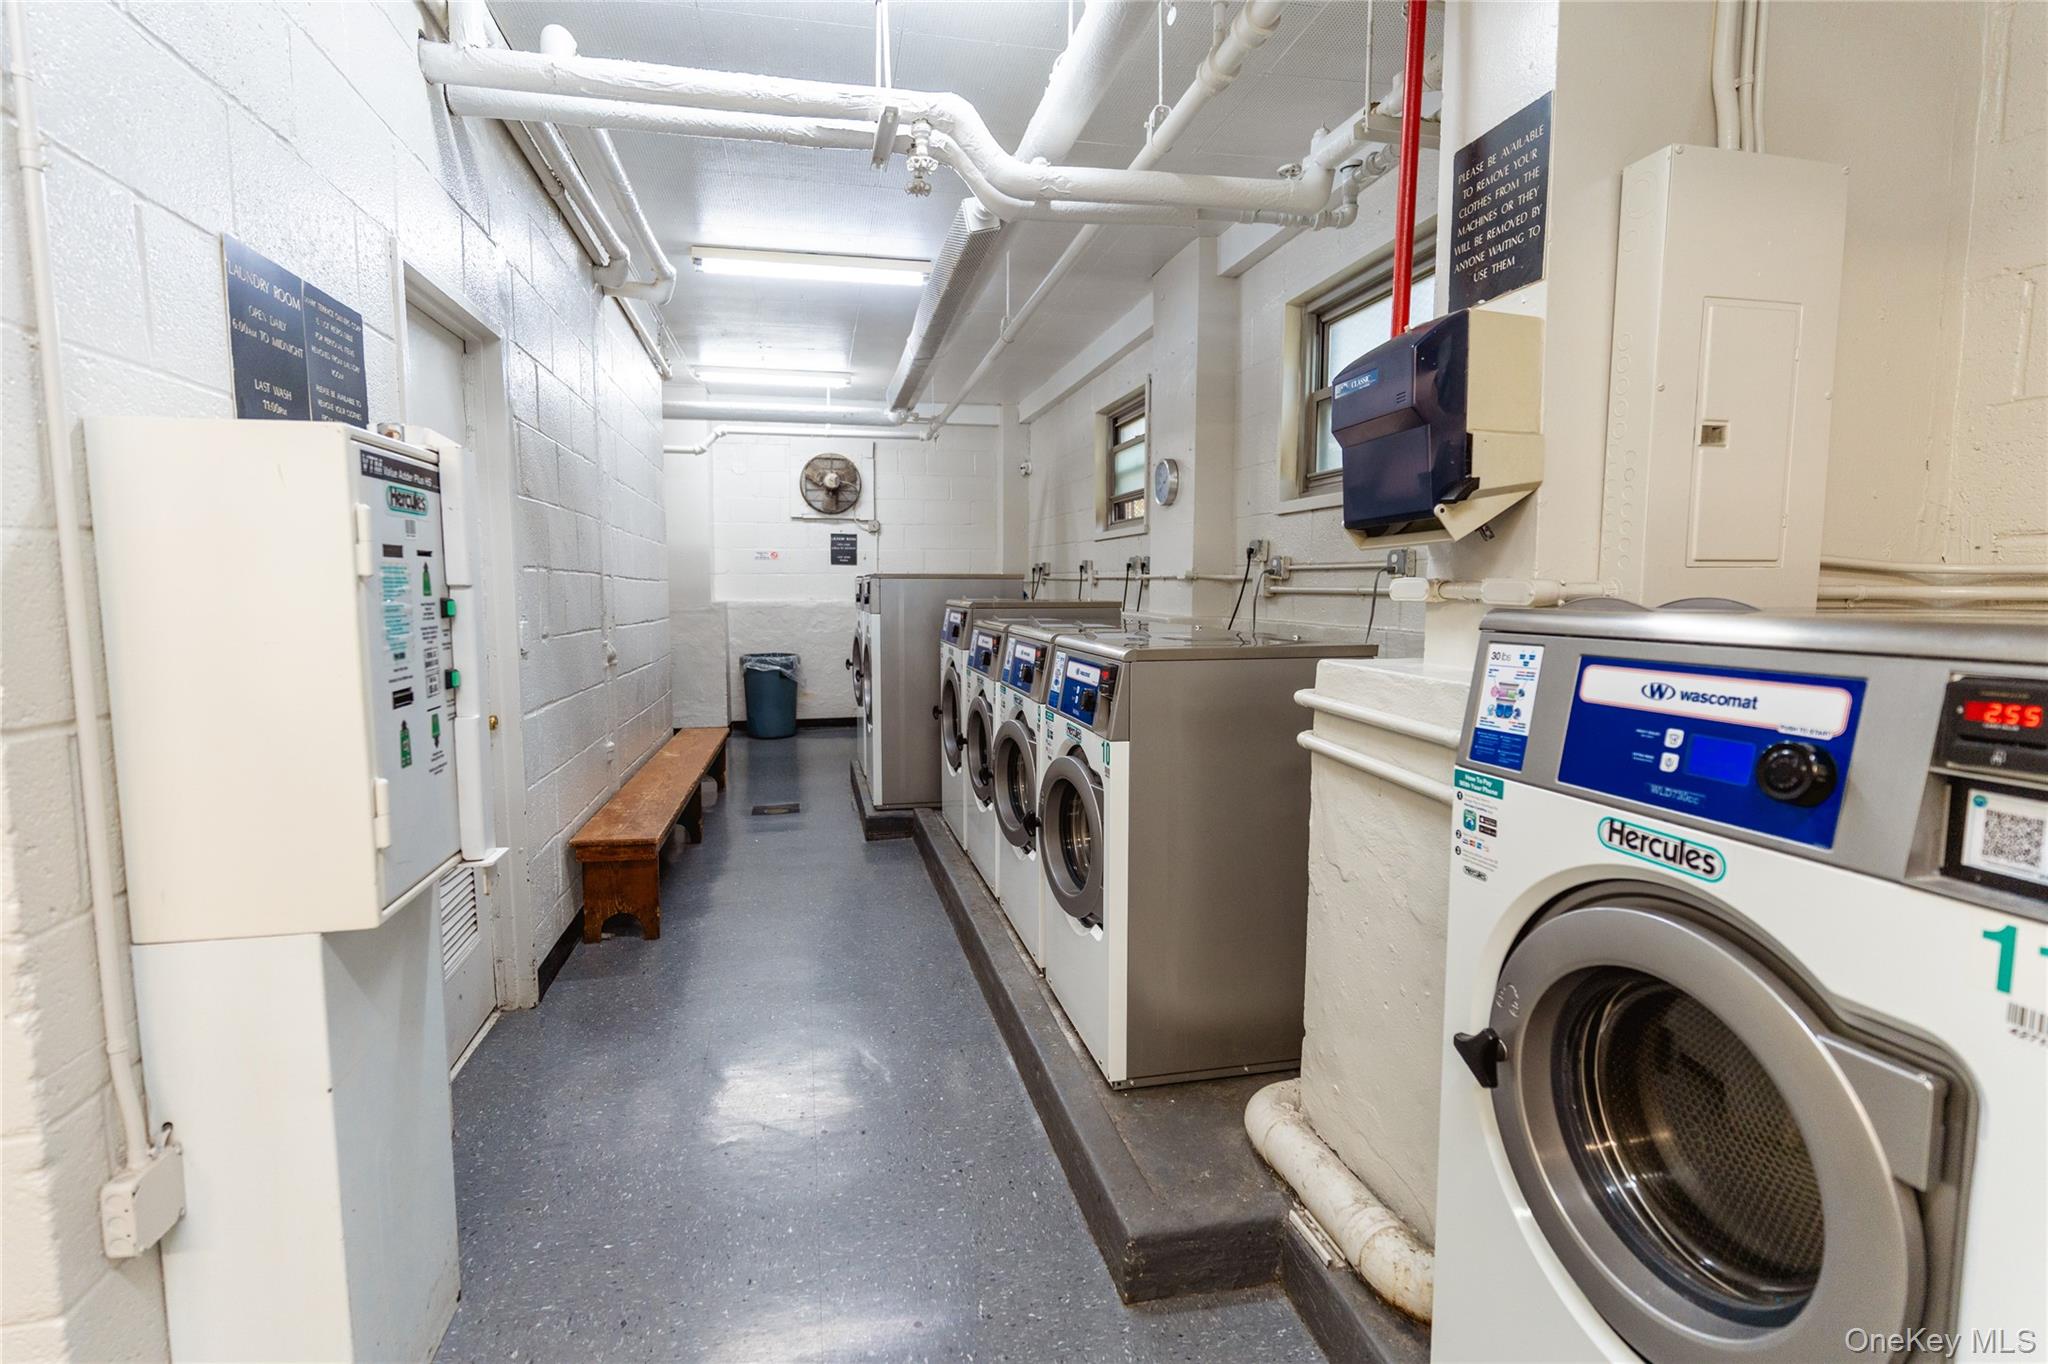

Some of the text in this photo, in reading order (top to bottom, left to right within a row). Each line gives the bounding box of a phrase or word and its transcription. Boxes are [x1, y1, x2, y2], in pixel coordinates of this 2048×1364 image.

[1458, 124, 1544, 184] PLEASE BE AVAILABLE
[1463, 148, 1538, 199] TO REMOVE YOUR
[1458, 166, 1540, 219] CLOTHES FROM THE
[1458, 185, 1540, 237] MACHINES OR THEY
[1454, 203, 1543, 256] WILL BE REMOVED BY
[1454, 224, 1541, 273] ANYONE WAITING TO
[228, 260, 301, 311] LAUNDRY ROOM
[1473, 256, 1515, 282] USE THEM
[259, 330, 270, 343] TO
[272, 336, 304, 359] MIDNIGHT
[254, 379, 292, 401] LAST WASH
[390, 486, 426, 512] Hercules
[1491, 651, 1512, 662] 30 lbs
[1680, 689, 1758, 710] wascomat
[1101, 741, 1110, 766] 10
[1465, 774, 1492, 788] How To Pay
[1608, 819, 1716, 875] Hercules
[1982, 925, 2048, 993] 1
